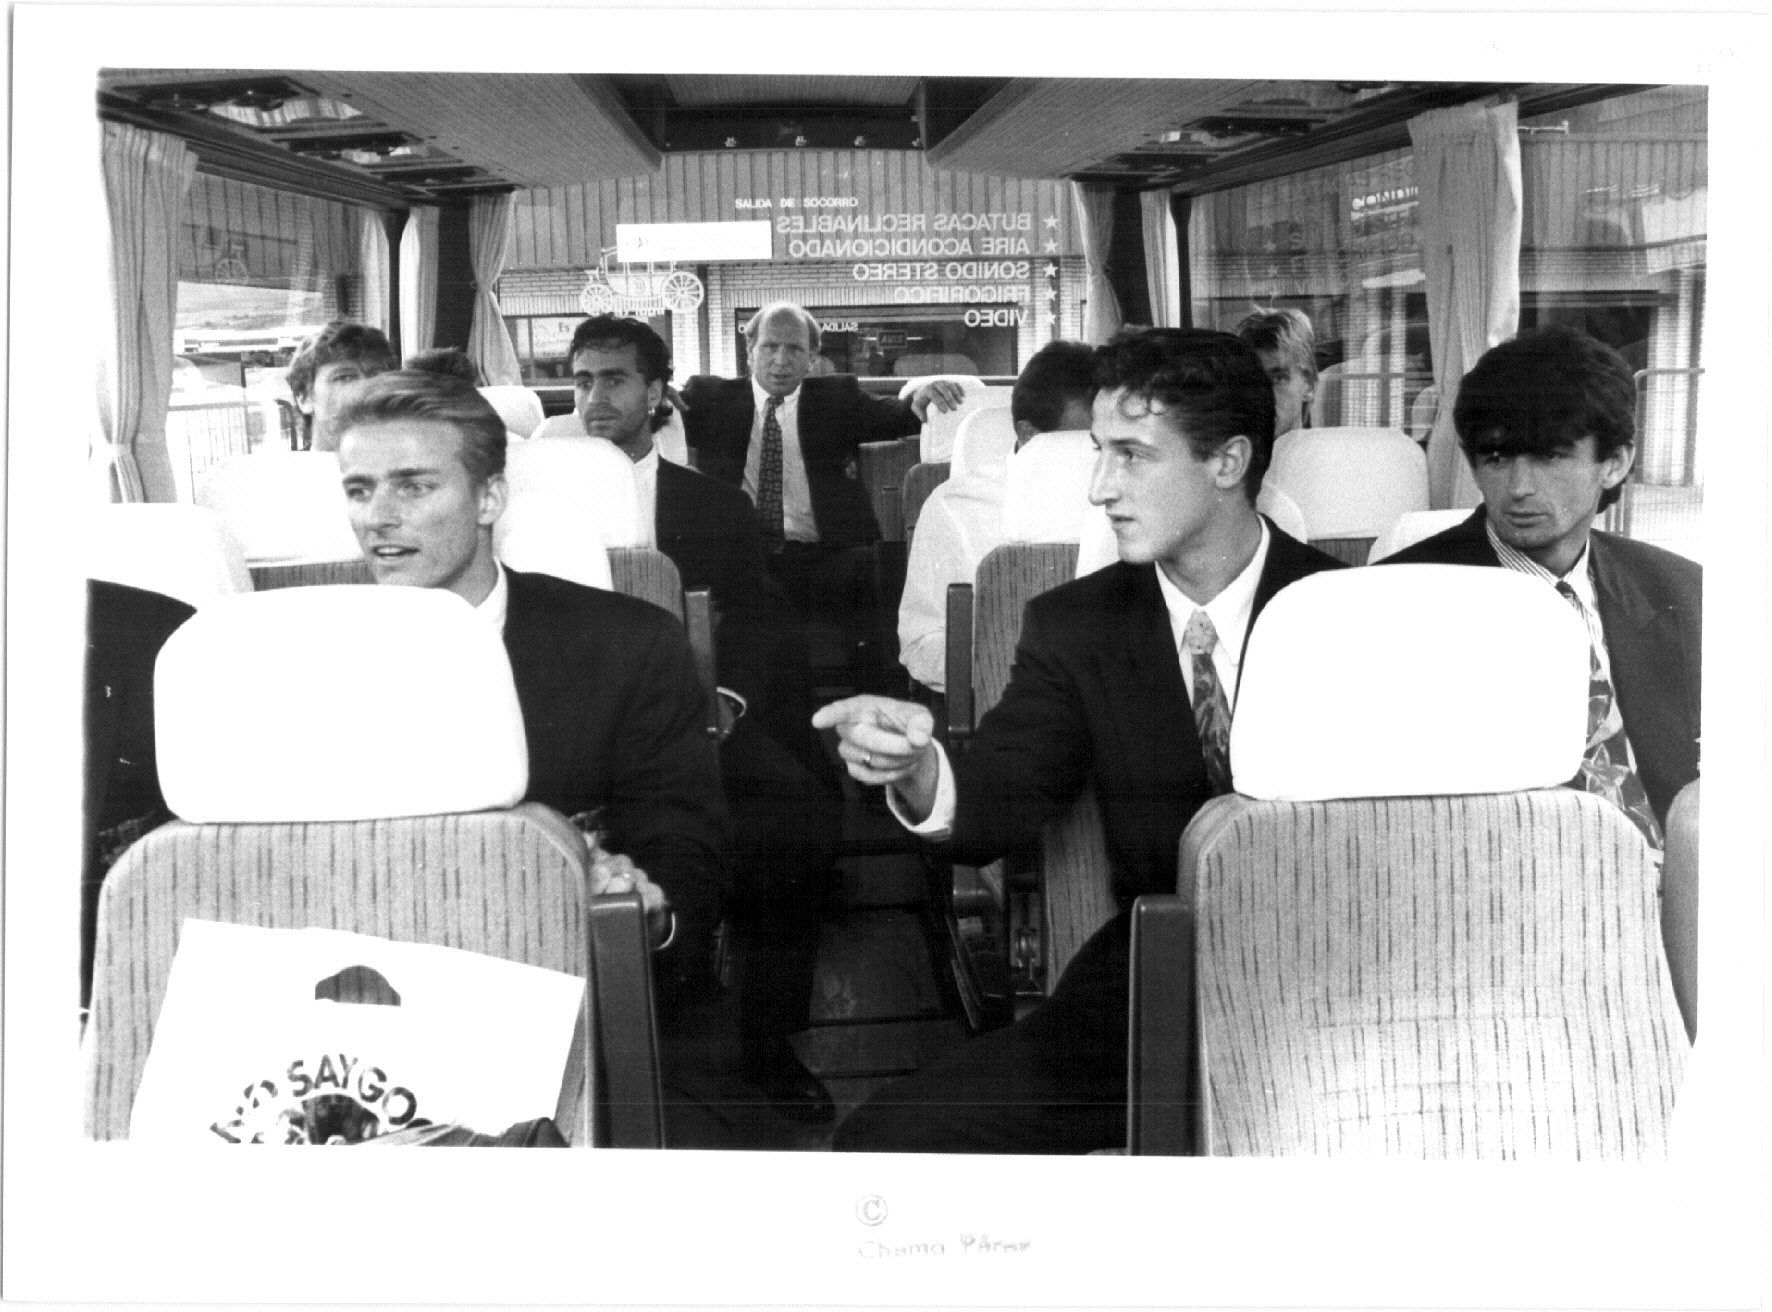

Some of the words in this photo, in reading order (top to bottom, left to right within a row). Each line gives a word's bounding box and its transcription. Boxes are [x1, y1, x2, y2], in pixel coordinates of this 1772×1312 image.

[734, 197, 772, 209] SALIDA
[780, 198, 795, 209] DE
[803, 197, 859, 208] SOCORRO
[287, 1053, 417, 1126] SAYGO
